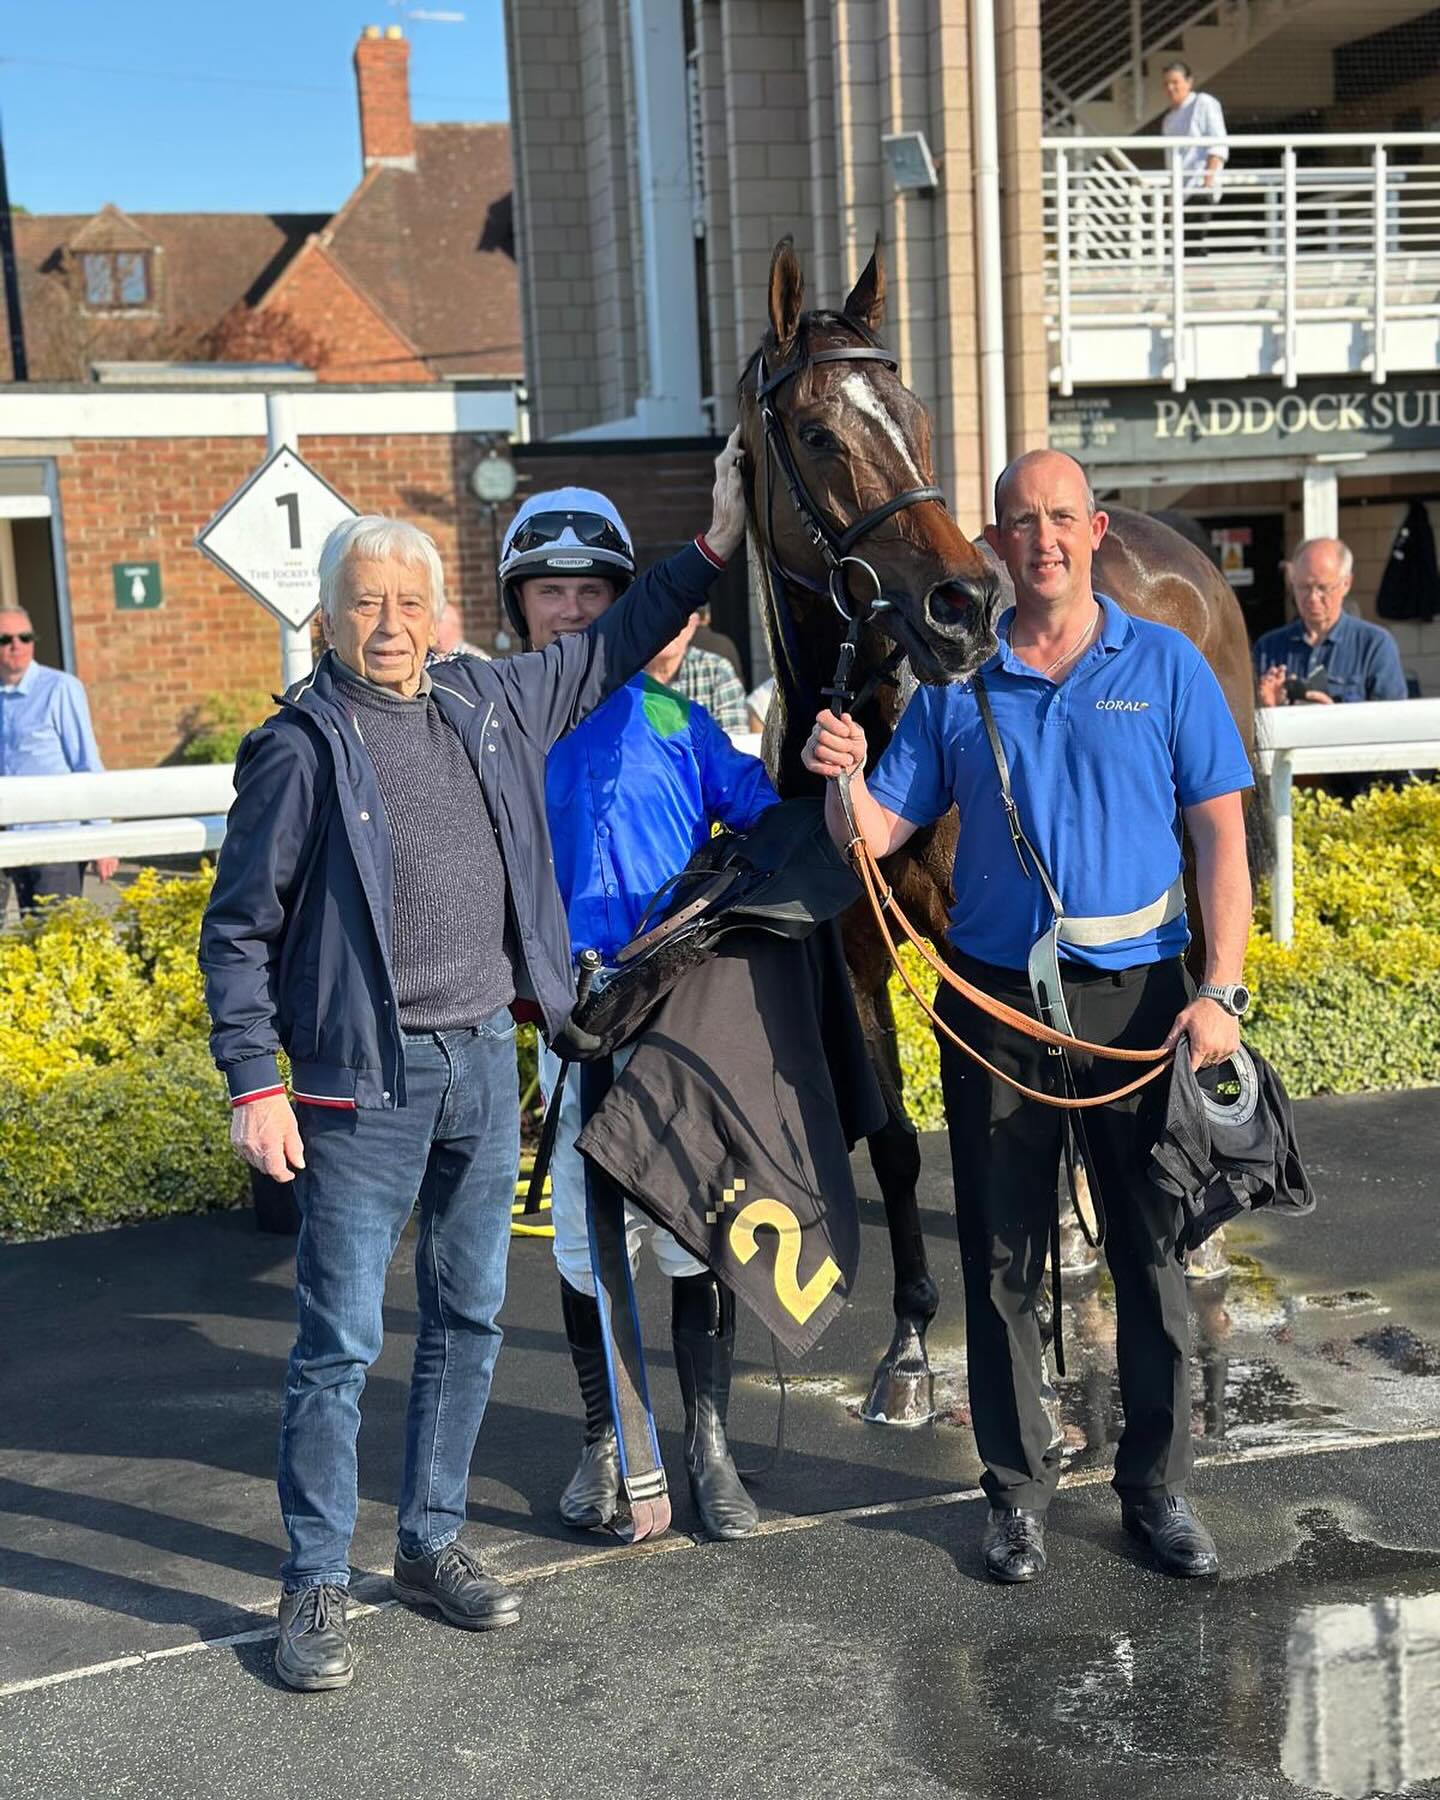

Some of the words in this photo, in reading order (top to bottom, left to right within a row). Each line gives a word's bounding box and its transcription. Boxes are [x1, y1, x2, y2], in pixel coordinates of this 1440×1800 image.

[1154, 393, 1367, 438] PADDOCK
[275, 492, 302, 549] 1
[249, 568, 270, 579] THE
[273, 568, 308, 580] JOCKEY
[1095, 700, 1141, 711] CORAL
[729, 1198, 842, 1325] 2
